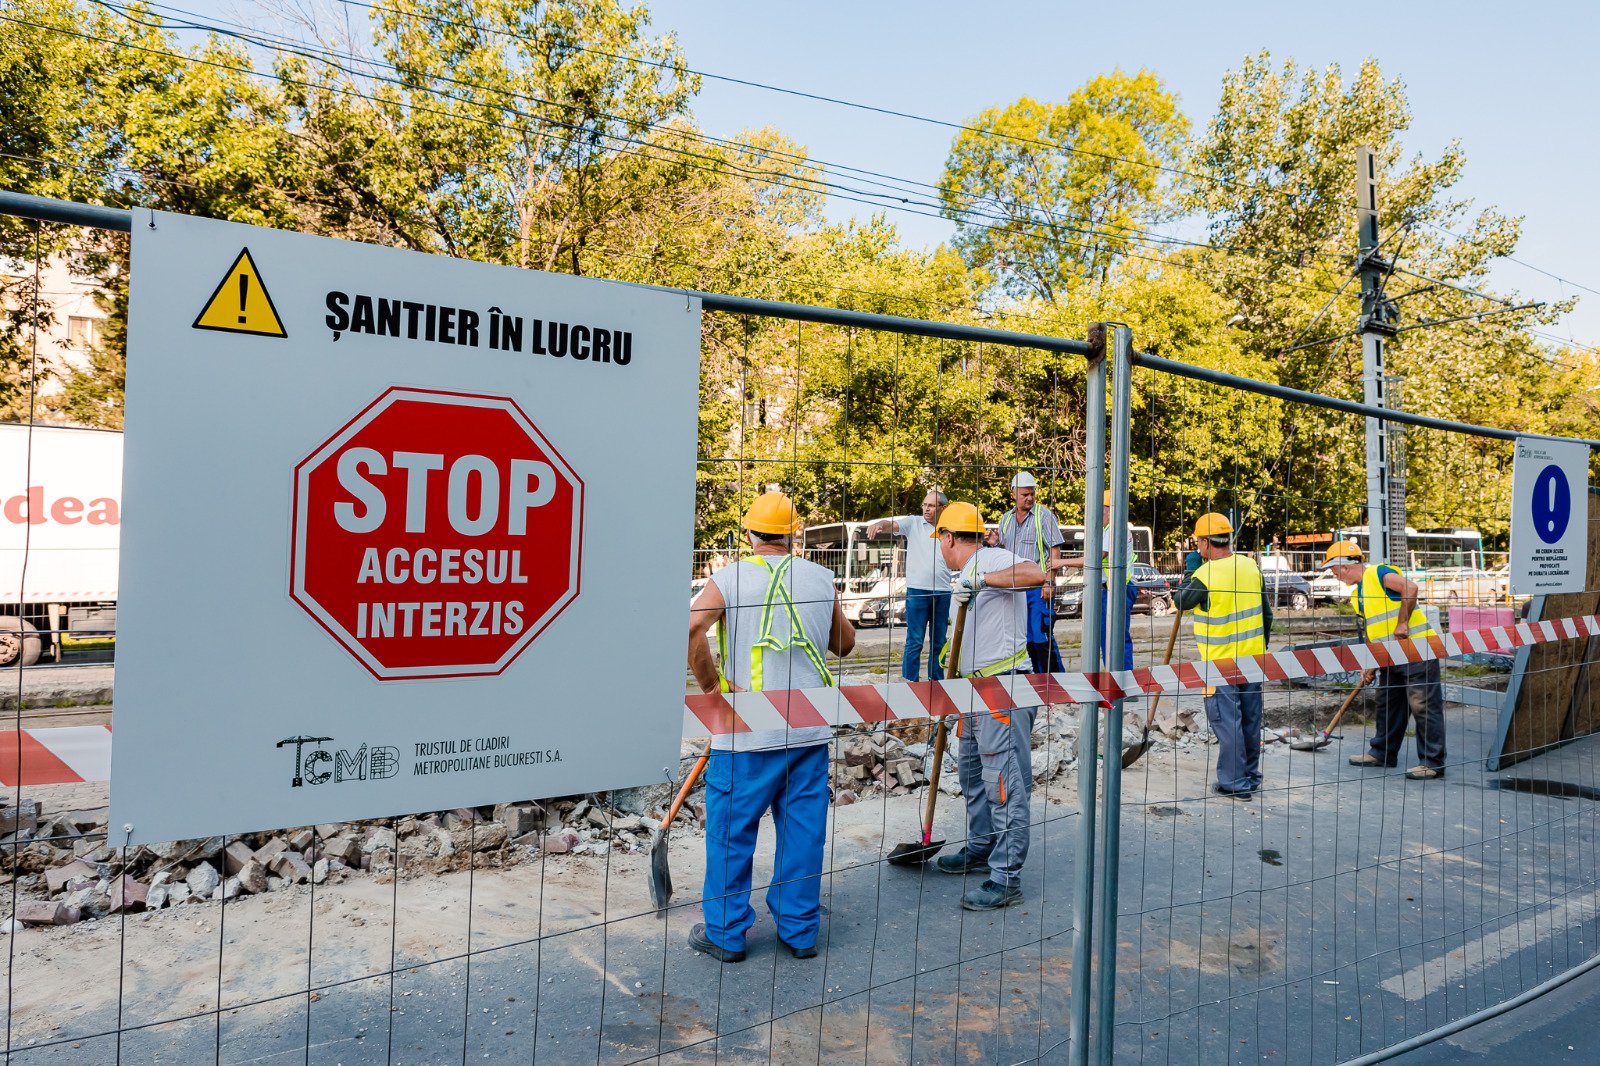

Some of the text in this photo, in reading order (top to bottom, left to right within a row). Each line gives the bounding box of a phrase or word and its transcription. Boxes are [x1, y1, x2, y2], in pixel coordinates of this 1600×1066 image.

[486, 306, 523, 352] ÎN
[532, 318, 633, 366] LUCRU
[0, 485, 121, 526] dea
[334, 446, 557, 537] STOP
[356, 546, 529, 585] ACCESUL
[356, 600, 525, 639] INTERZIS
[413, 750, 563, 776] METROPOLITANE BUCURESTI S.A.
[414, 736, 510, 757] TRUSTUL DE CLADIRI
